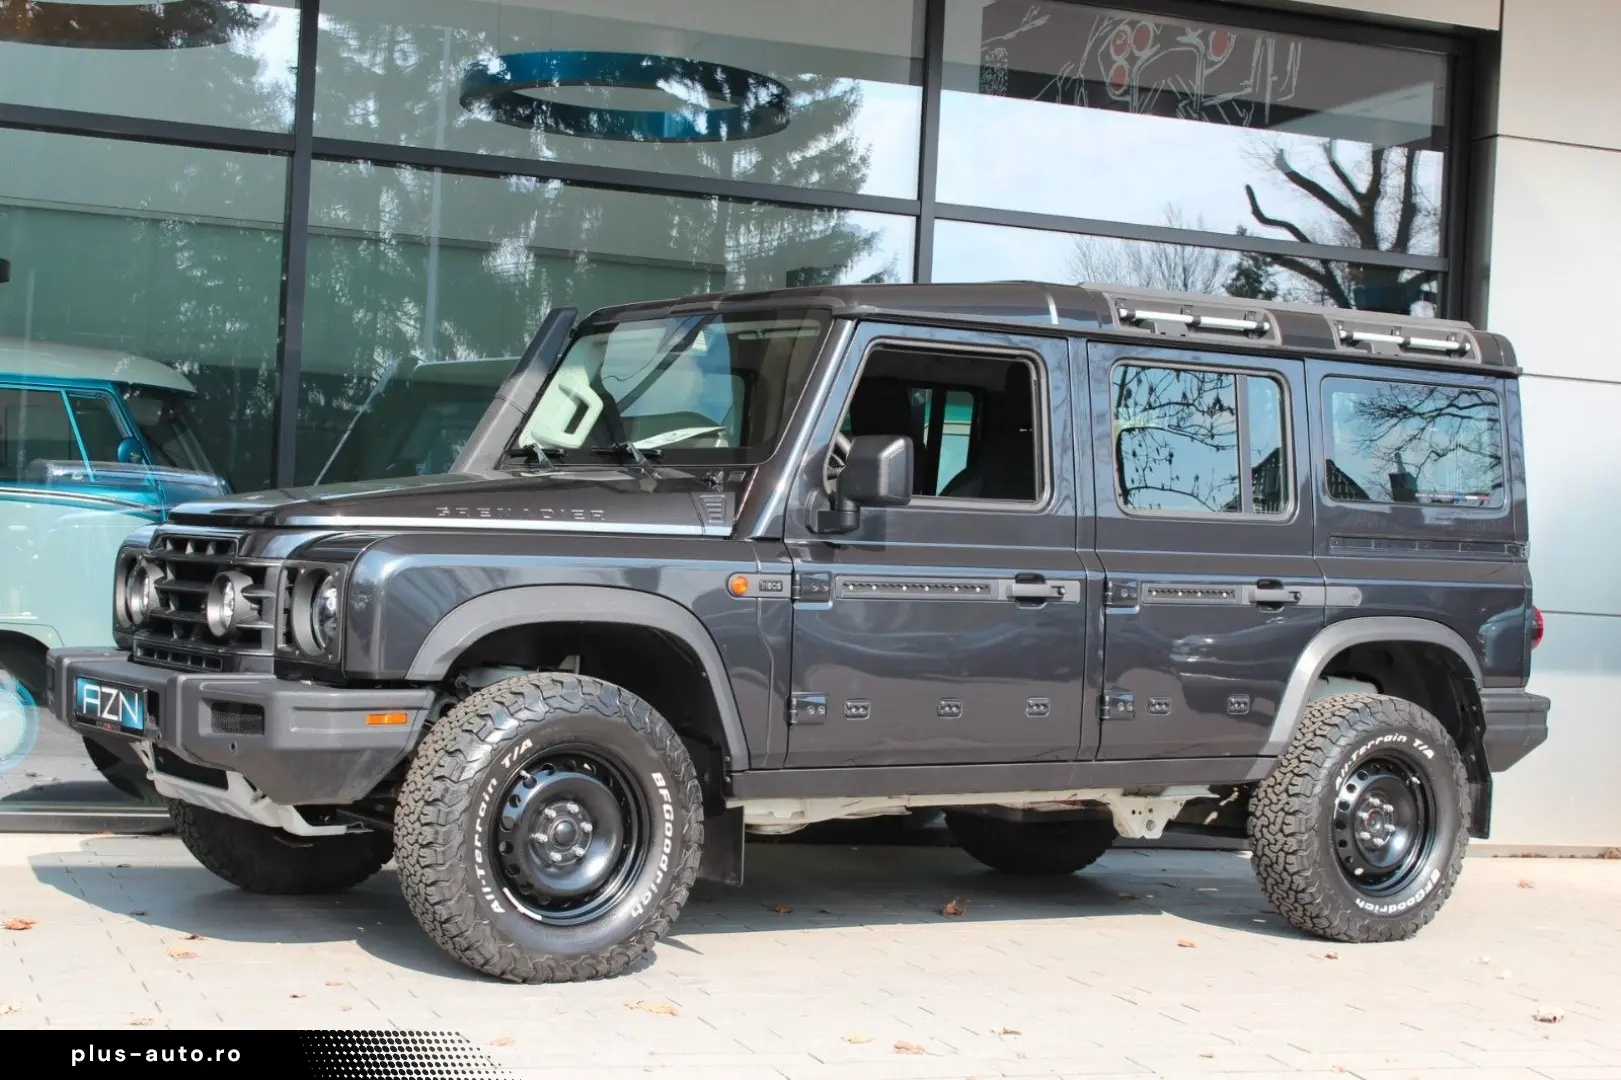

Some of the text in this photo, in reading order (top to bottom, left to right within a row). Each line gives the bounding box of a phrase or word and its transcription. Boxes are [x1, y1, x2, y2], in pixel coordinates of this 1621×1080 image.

[435, 505, 605, 521] GREDER
[83, 684, 139, 726] AZN
[501, 738, 532, 768] T/A
[1412, 738, 1435, 760] T/A
[631, 772, 674, 918] BFGoodrich
